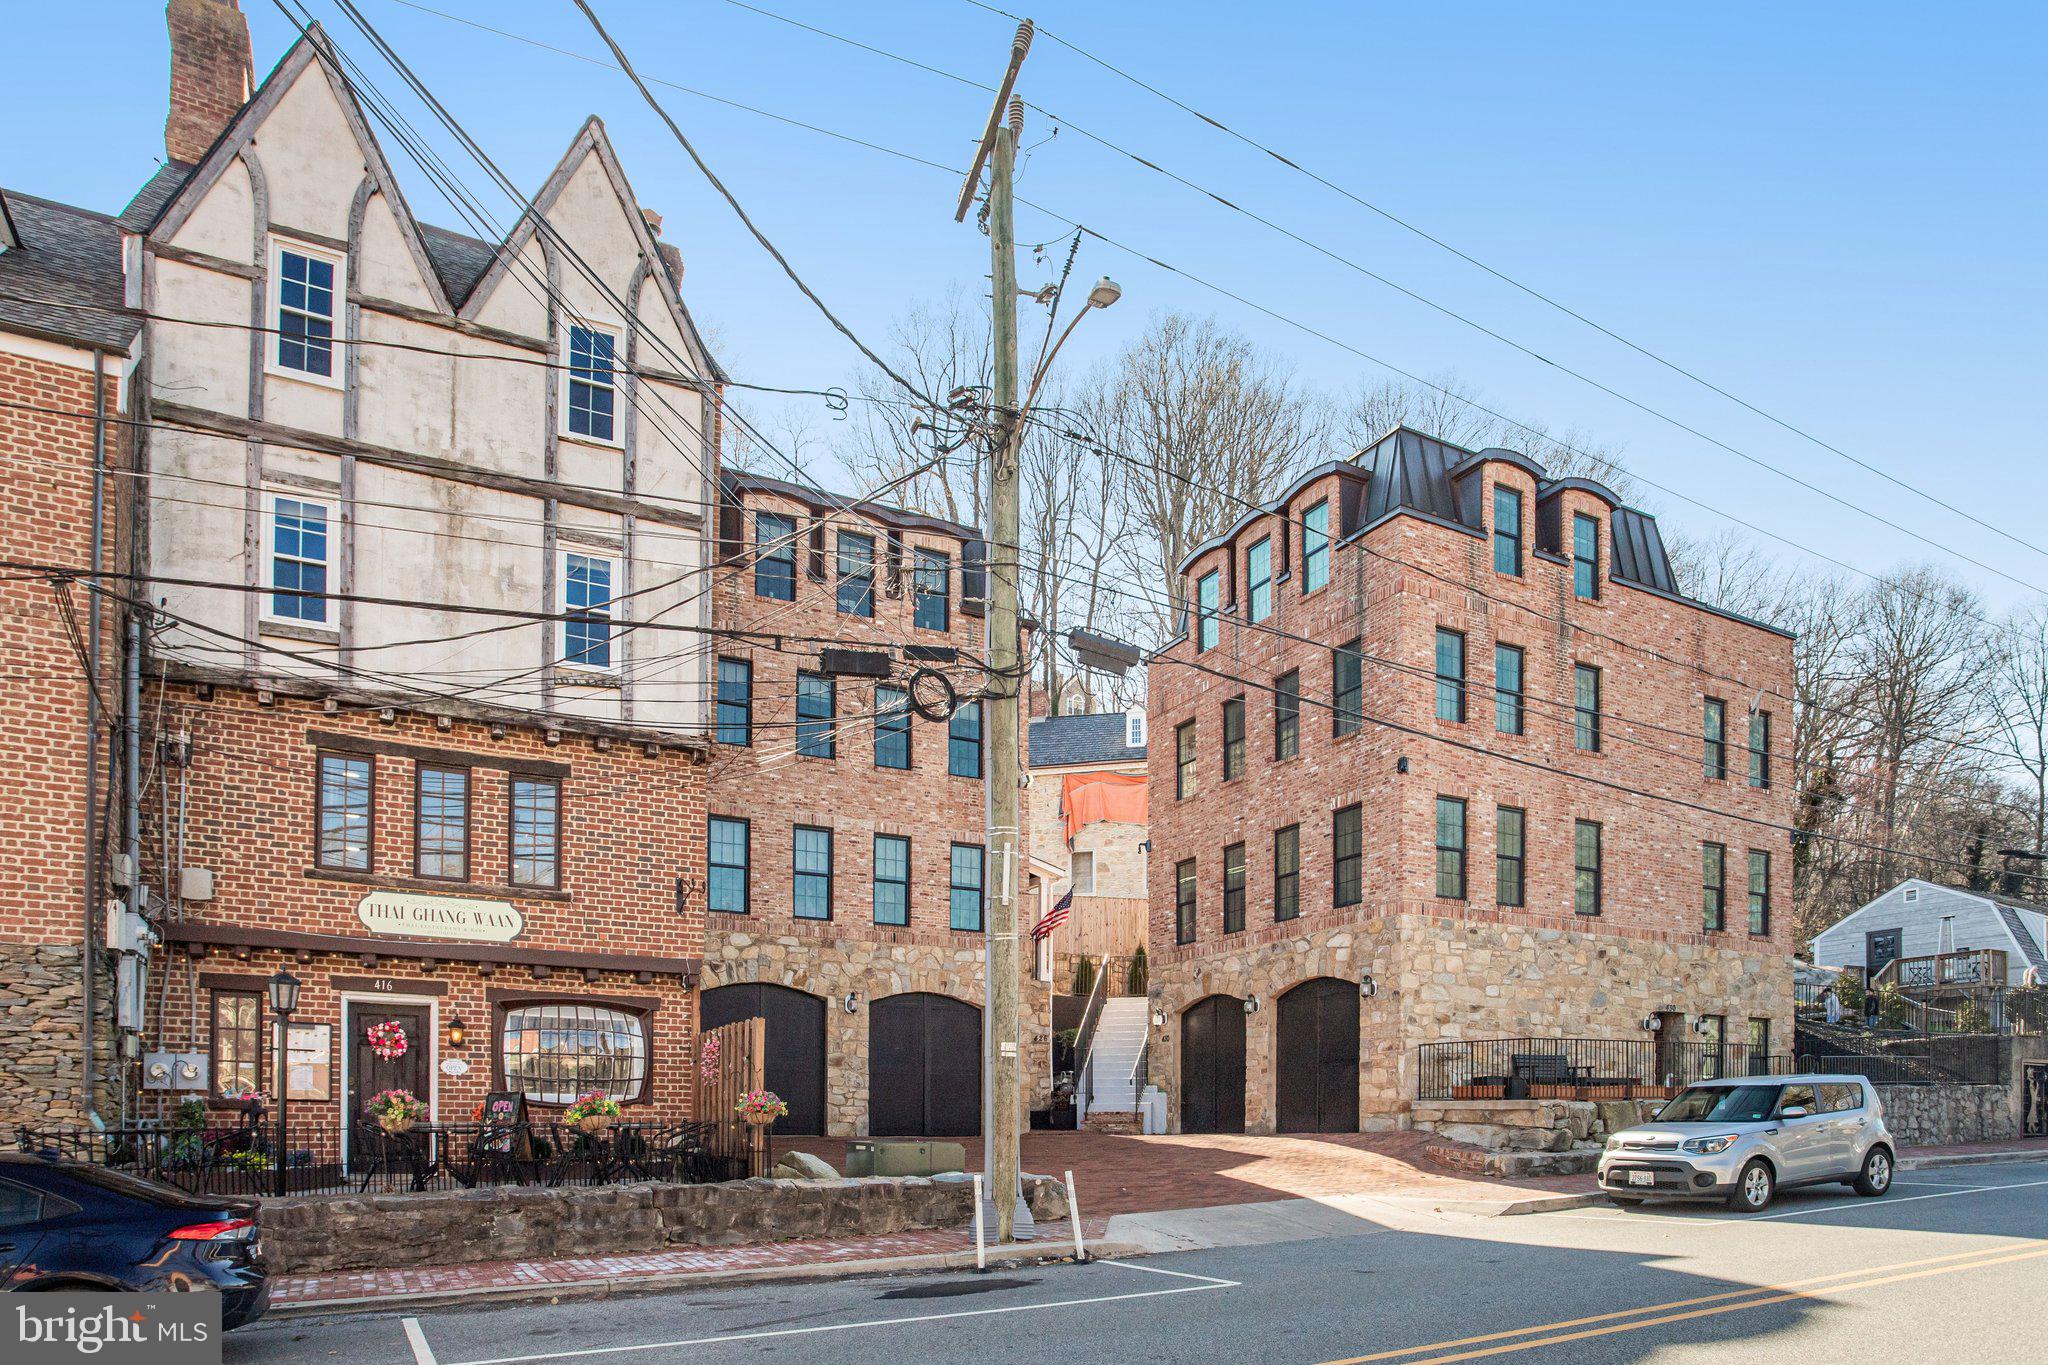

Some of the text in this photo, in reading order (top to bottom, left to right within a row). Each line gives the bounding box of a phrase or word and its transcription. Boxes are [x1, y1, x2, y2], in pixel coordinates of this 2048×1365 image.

[367, 903, 514, 928] THAI GHANG WAAN
[374, 979, 393, 991] 416
[492, 1100, 514, 1112] OPEN
